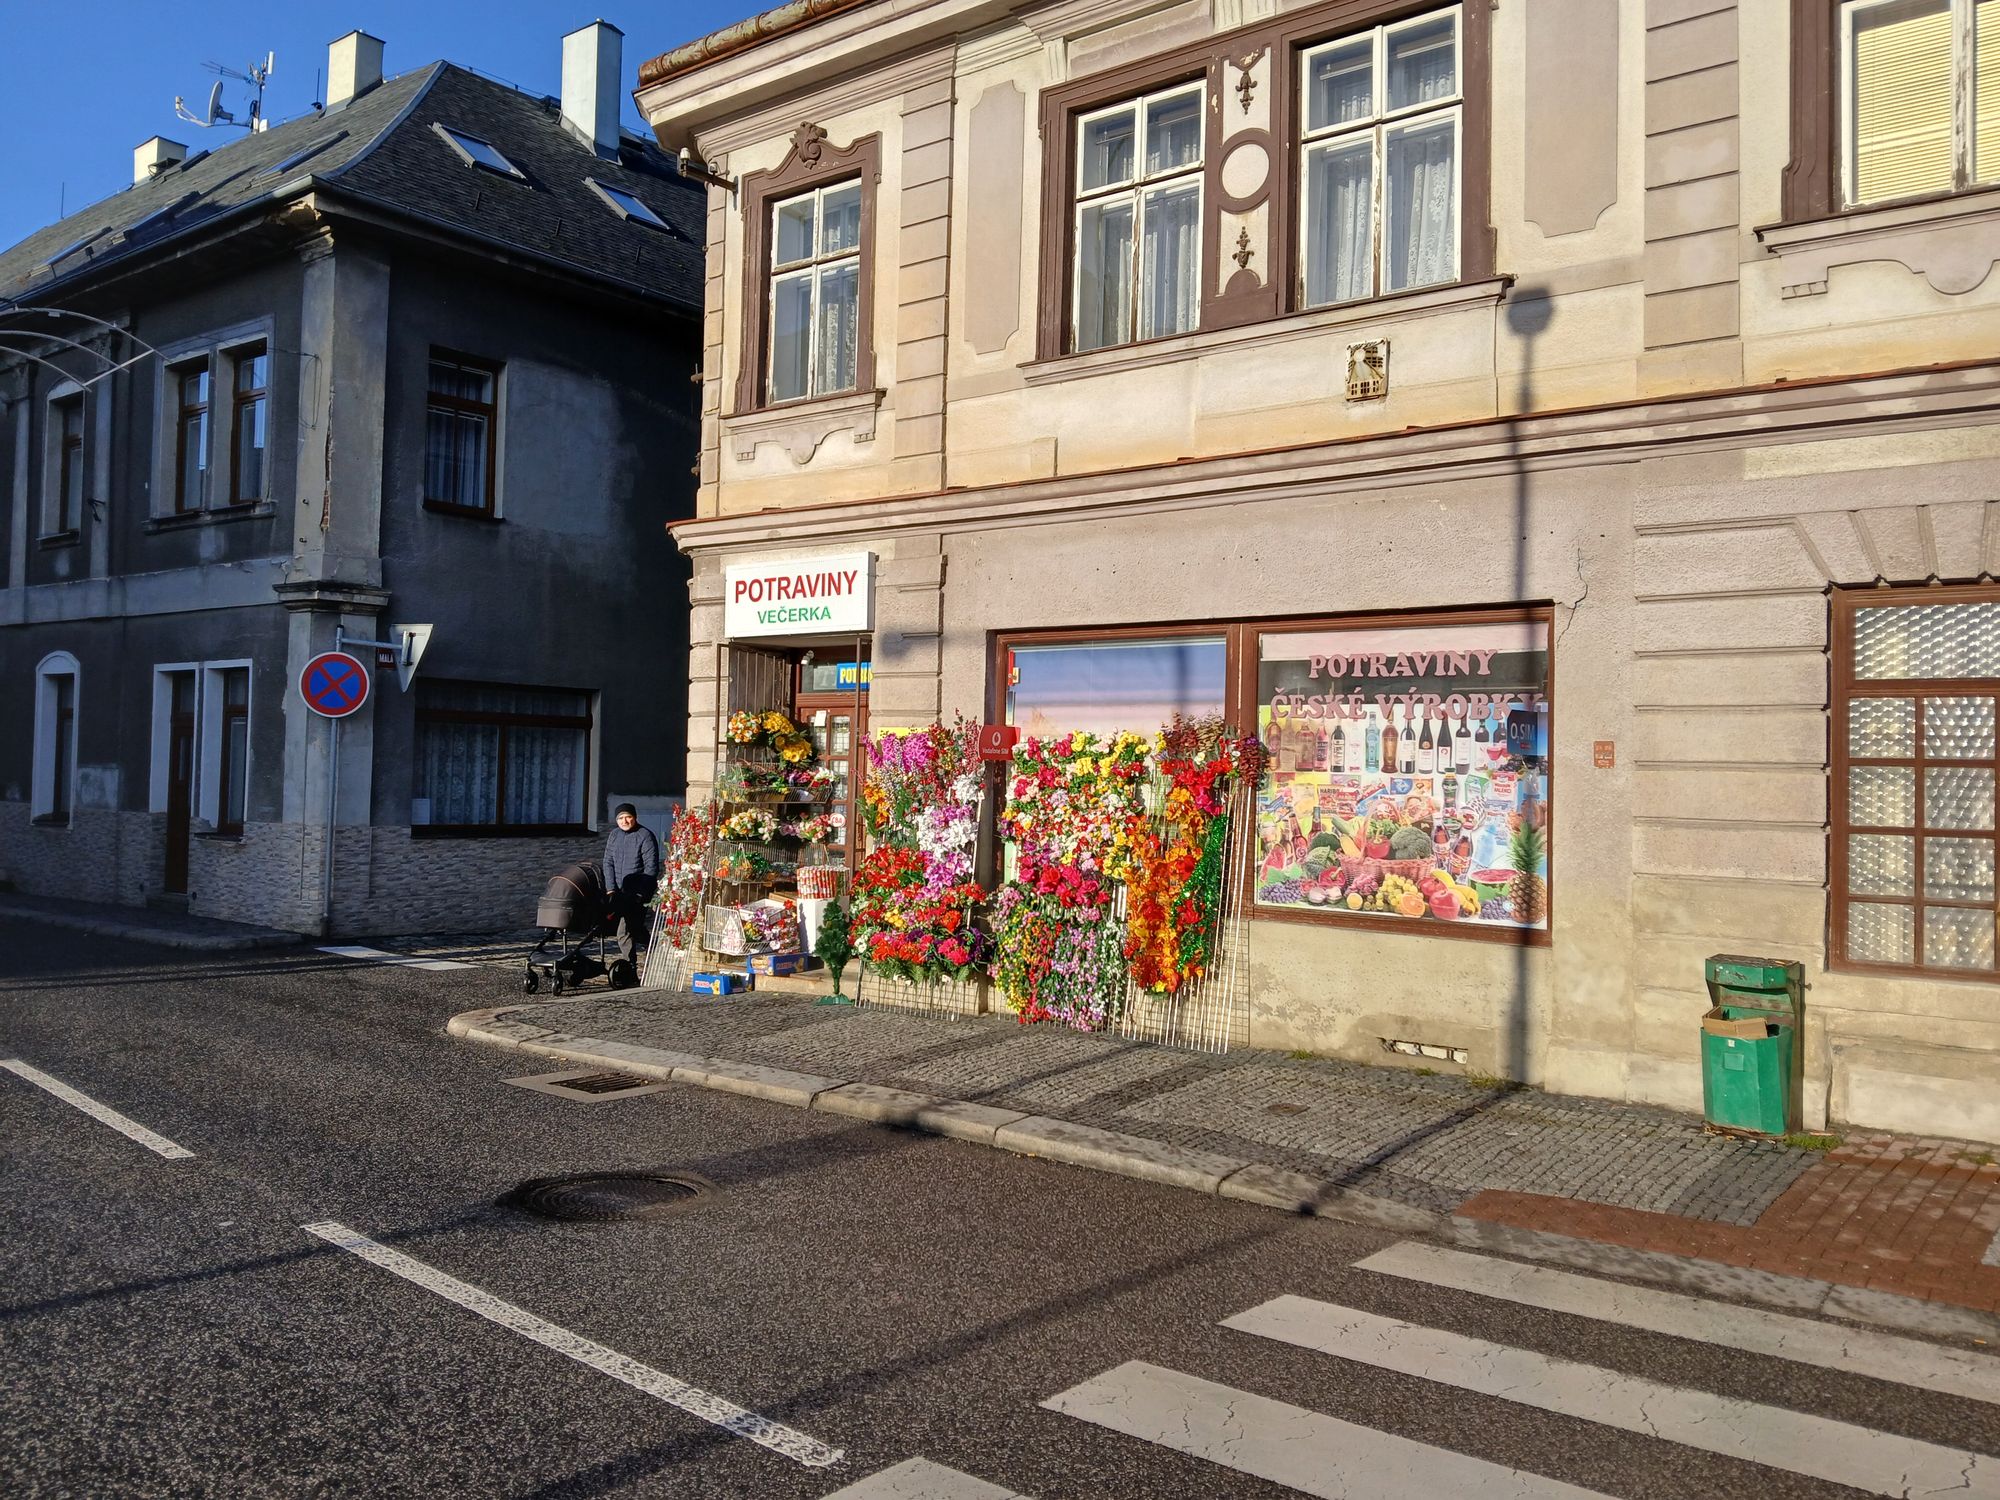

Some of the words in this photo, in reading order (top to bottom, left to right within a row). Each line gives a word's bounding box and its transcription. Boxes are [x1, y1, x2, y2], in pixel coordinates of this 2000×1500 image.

[735, 570, 858, 604] POTRAVINY
[757, 606, 832, 624] VEČERKA
[1308, 649, 1498, 679] POTRAVINY
[1269, 686, 1368, 720] ČESKÉ
[1375, 686, 1544, 721] VÝROBKY
